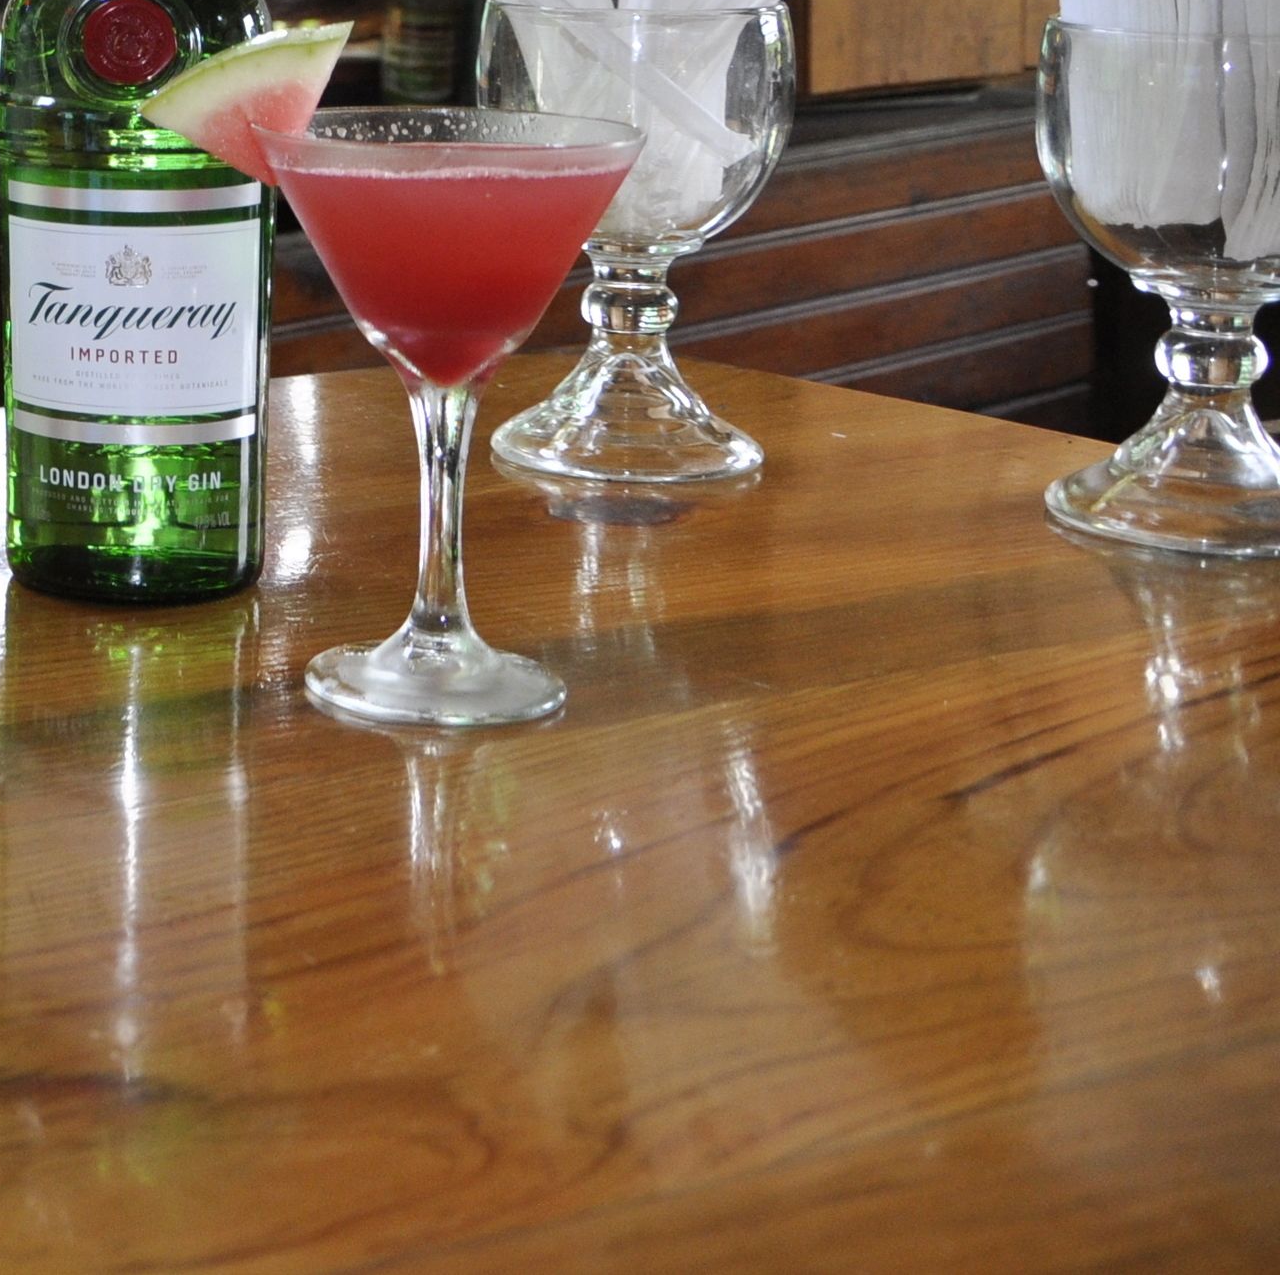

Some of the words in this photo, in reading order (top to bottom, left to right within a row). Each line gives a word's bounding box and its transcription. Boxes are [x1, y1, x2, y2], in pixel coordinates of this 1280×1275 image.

[27, 281, 237, 341] Tanqueray
[70, 346, 179, 365] IMPORTED
[40, 465, 124, 493] LONDON
[133, 474, 177, 494] DRY
[188, 471, 222, 493] GIN
